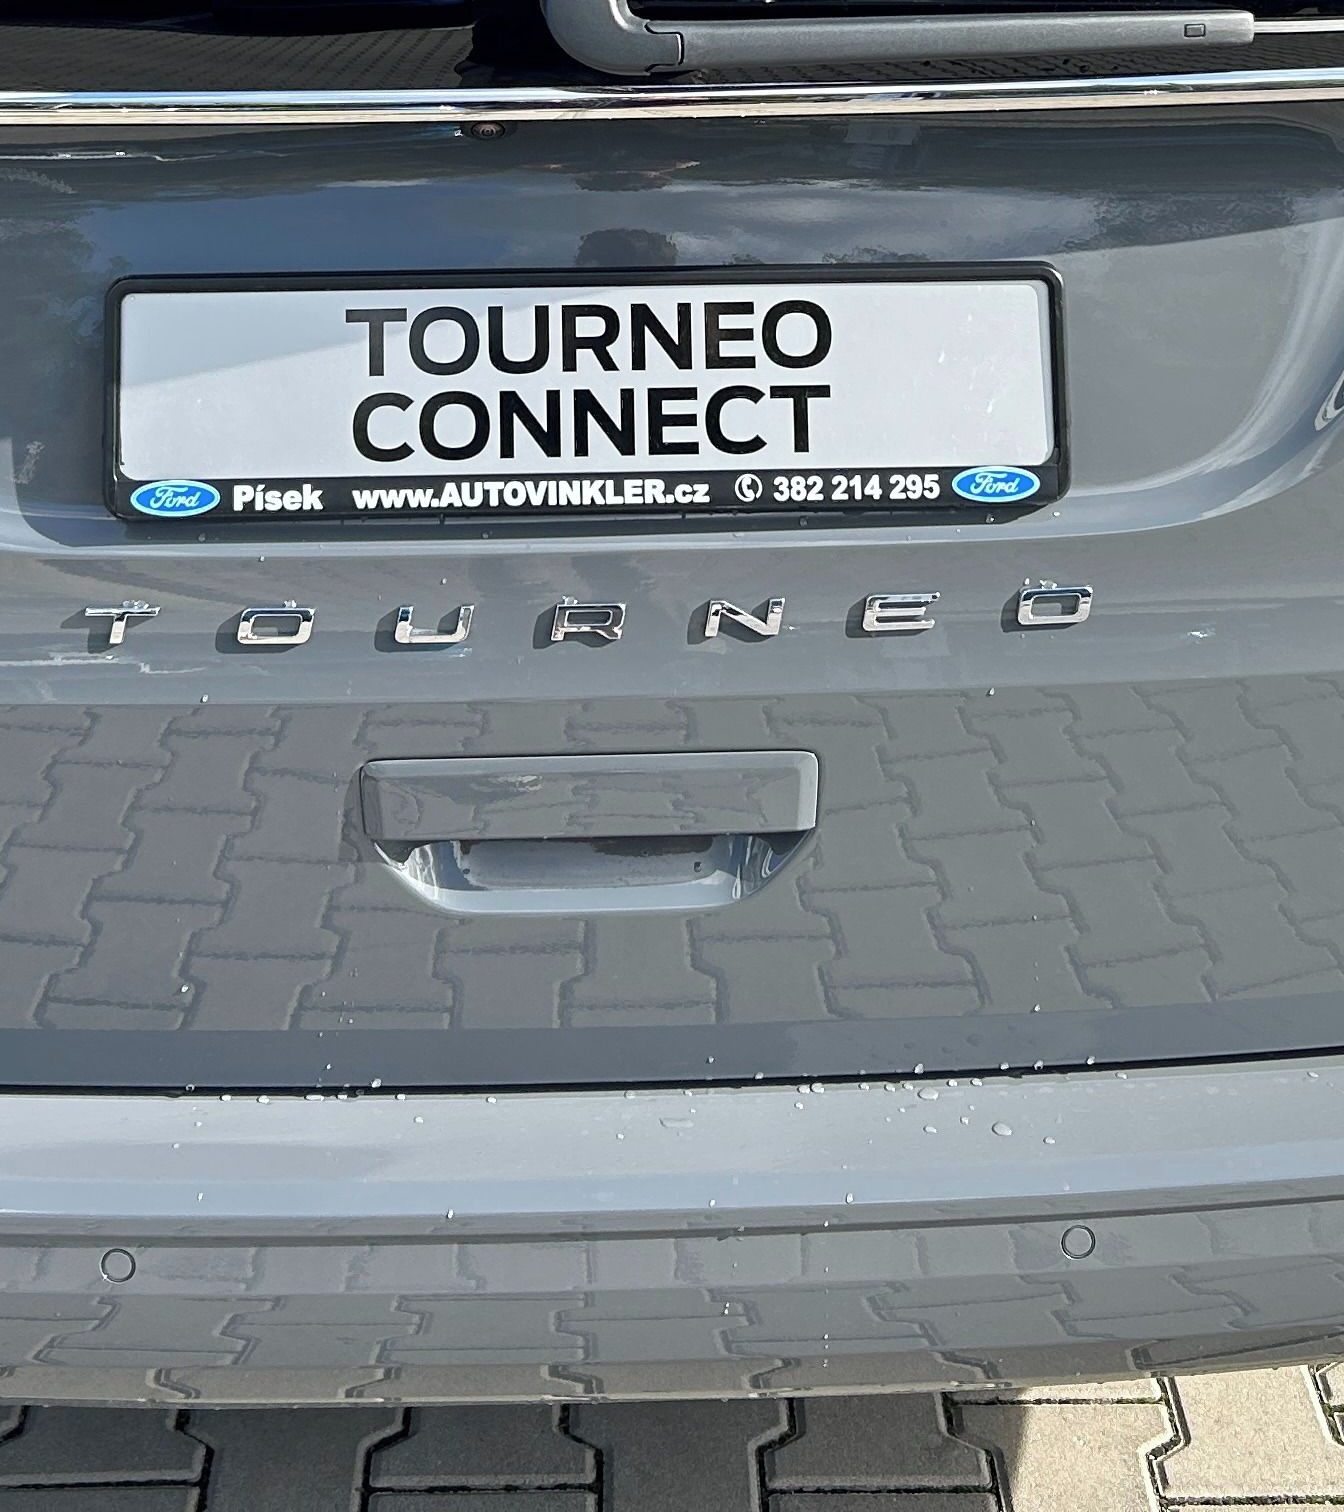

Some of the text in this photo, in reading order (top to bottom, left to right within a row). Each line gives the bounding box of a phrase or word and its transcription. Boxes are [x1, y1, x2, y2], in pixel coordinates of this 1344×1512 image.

[345, 300, 832, 377] TOURNEO
[353, 384, 831, 463] CONNECT
[149, 486, 200, 509] Ford
[233, 473, 941, 512] Písek www.AUTOVINKLER.cz 382 214 295
[969, 472, 1020, 494] Ford
[84, 583, 1093, 647] TOURNEO
